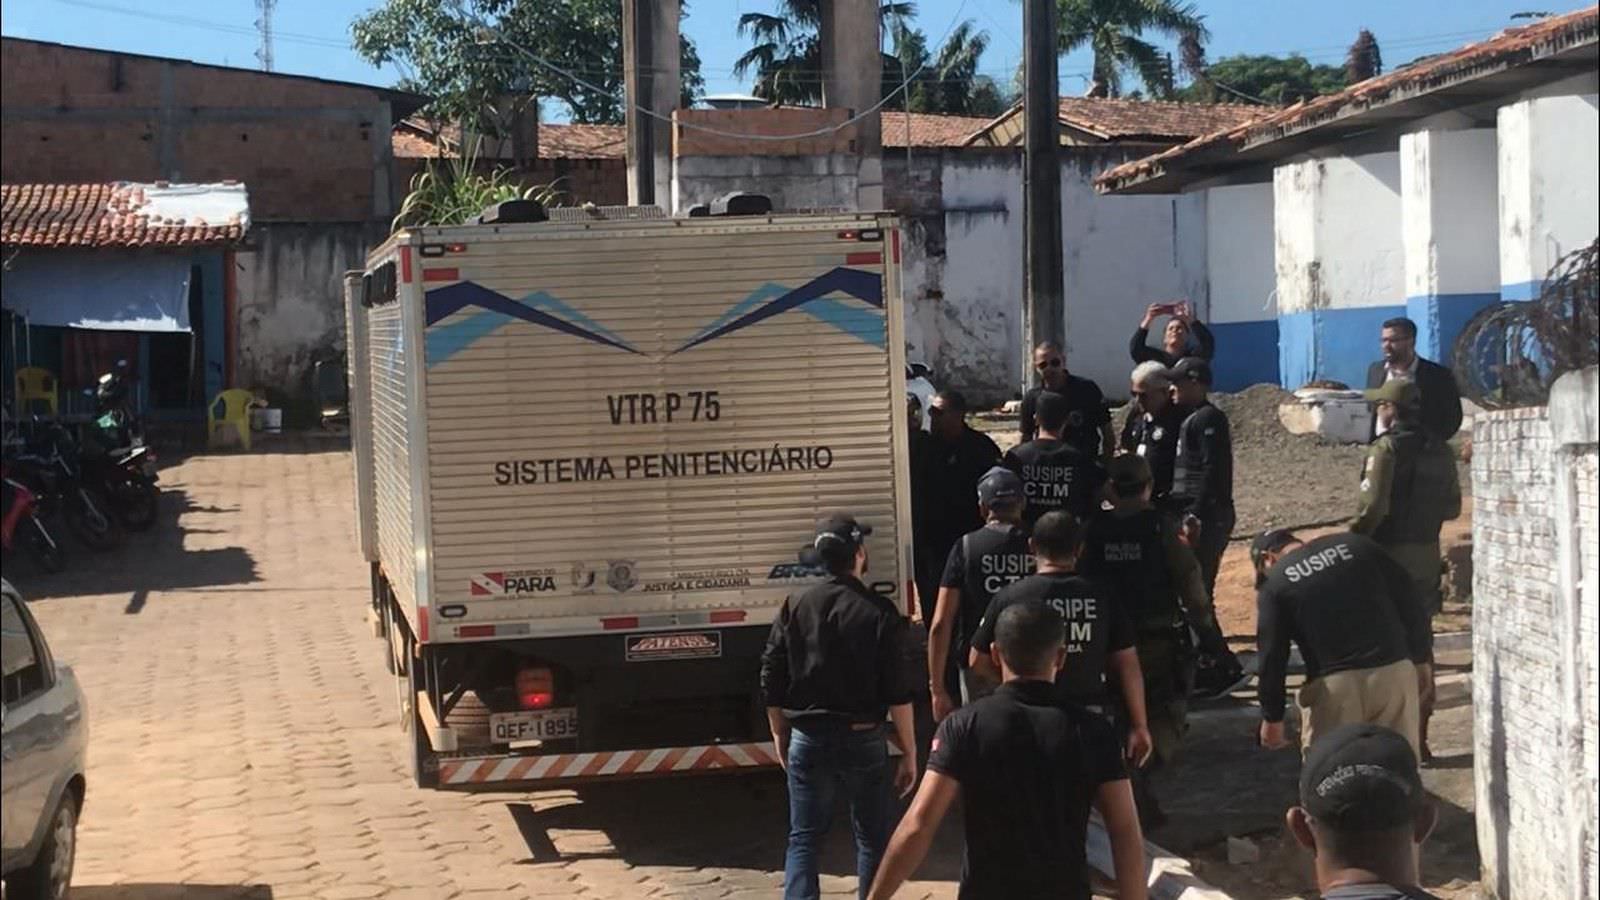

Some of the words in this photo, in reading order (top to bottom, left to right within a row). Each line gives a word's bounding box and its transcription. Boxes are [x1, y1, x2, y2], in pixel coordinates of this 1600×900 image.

[607, 394, 658, 425] VTR
[665, 391, 681, 423] P
[687, 390, 720, 422] 75
[495, 456, 615, 486] SISTEMA
[625, 443, 833, 479] PENITENCIÁRIO
[1022, 464, 1073, 482] SUSIPE
[1023, 482, 1069, 497] CTM
[981, 554, 1036, 575] SUSIP
[1284, 543, 1353, 582] SUSIPE
